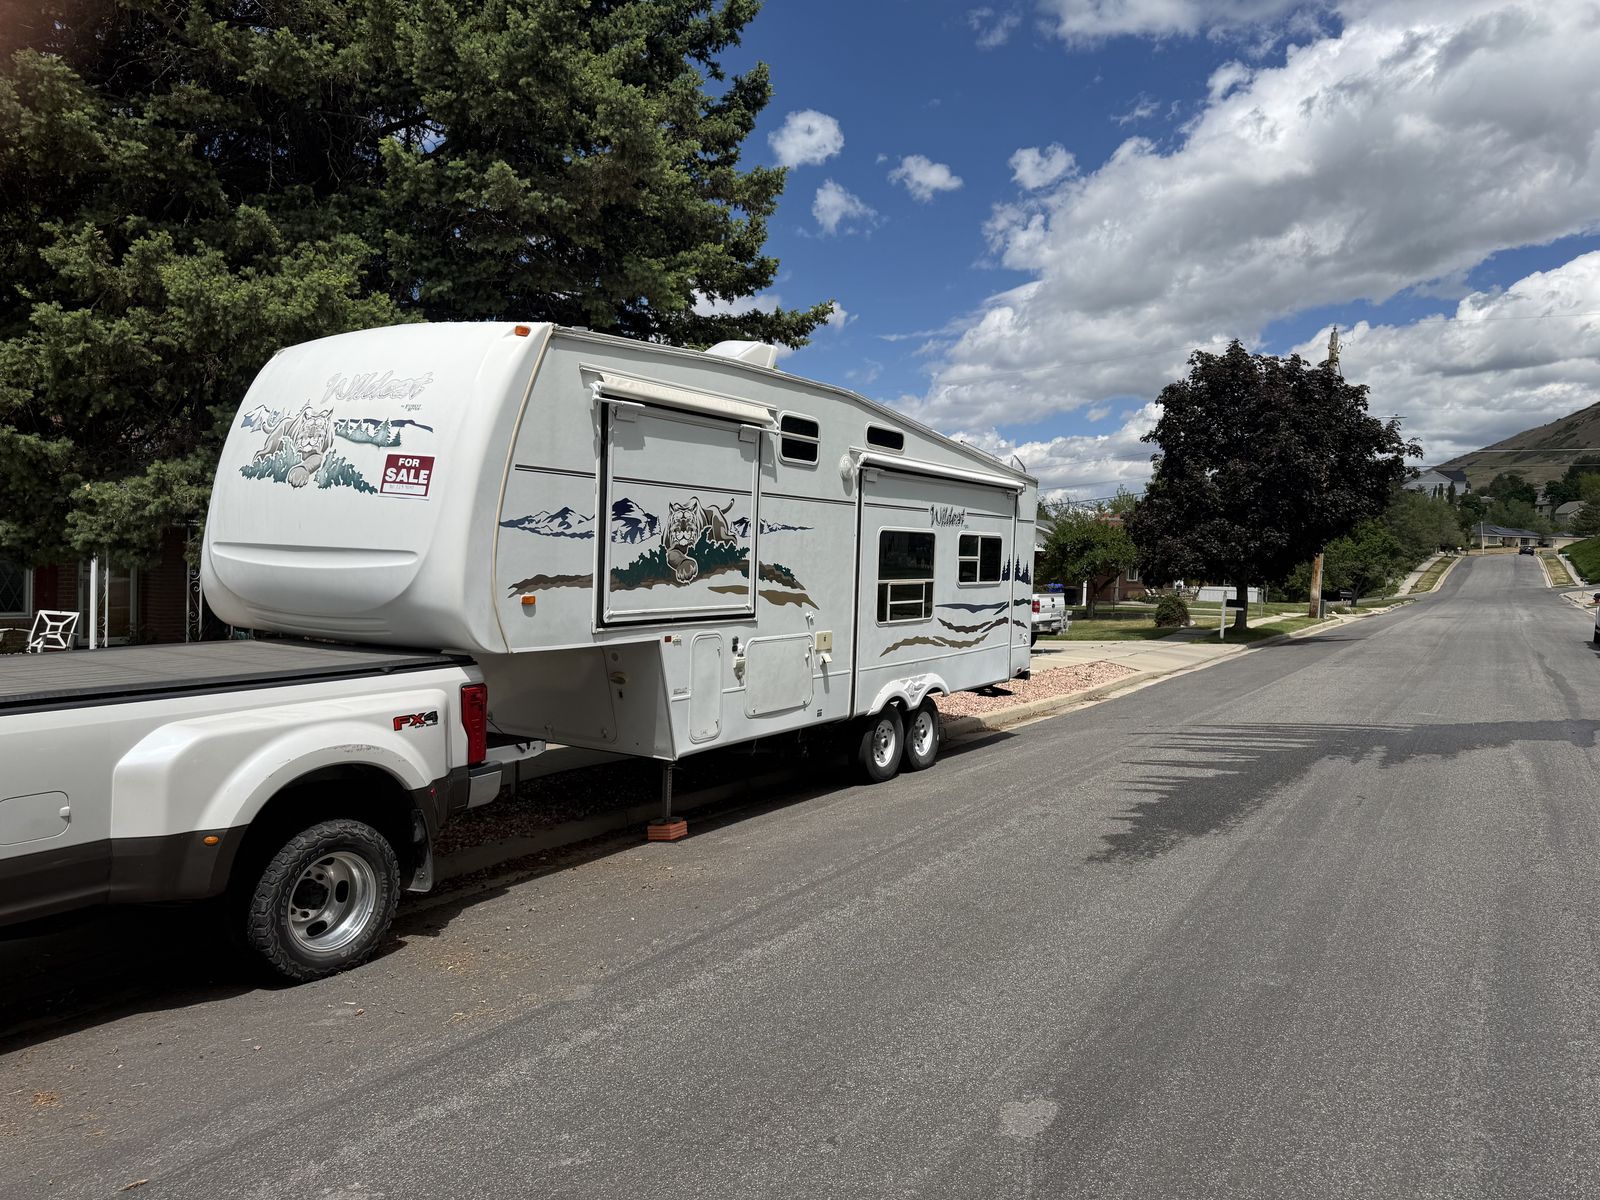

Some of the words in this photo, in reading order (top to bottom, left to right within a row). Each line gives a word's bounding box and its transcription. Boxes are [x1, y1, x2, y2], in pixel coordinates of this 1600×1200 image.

[320, 370, 434, 404] Wildcat
[398, 457, 420, 467] FOR
[384, 467, 430, 484] SALE
[930, 504, 966, 528] Wildcat
[392, 710, 439, 731] FX4
